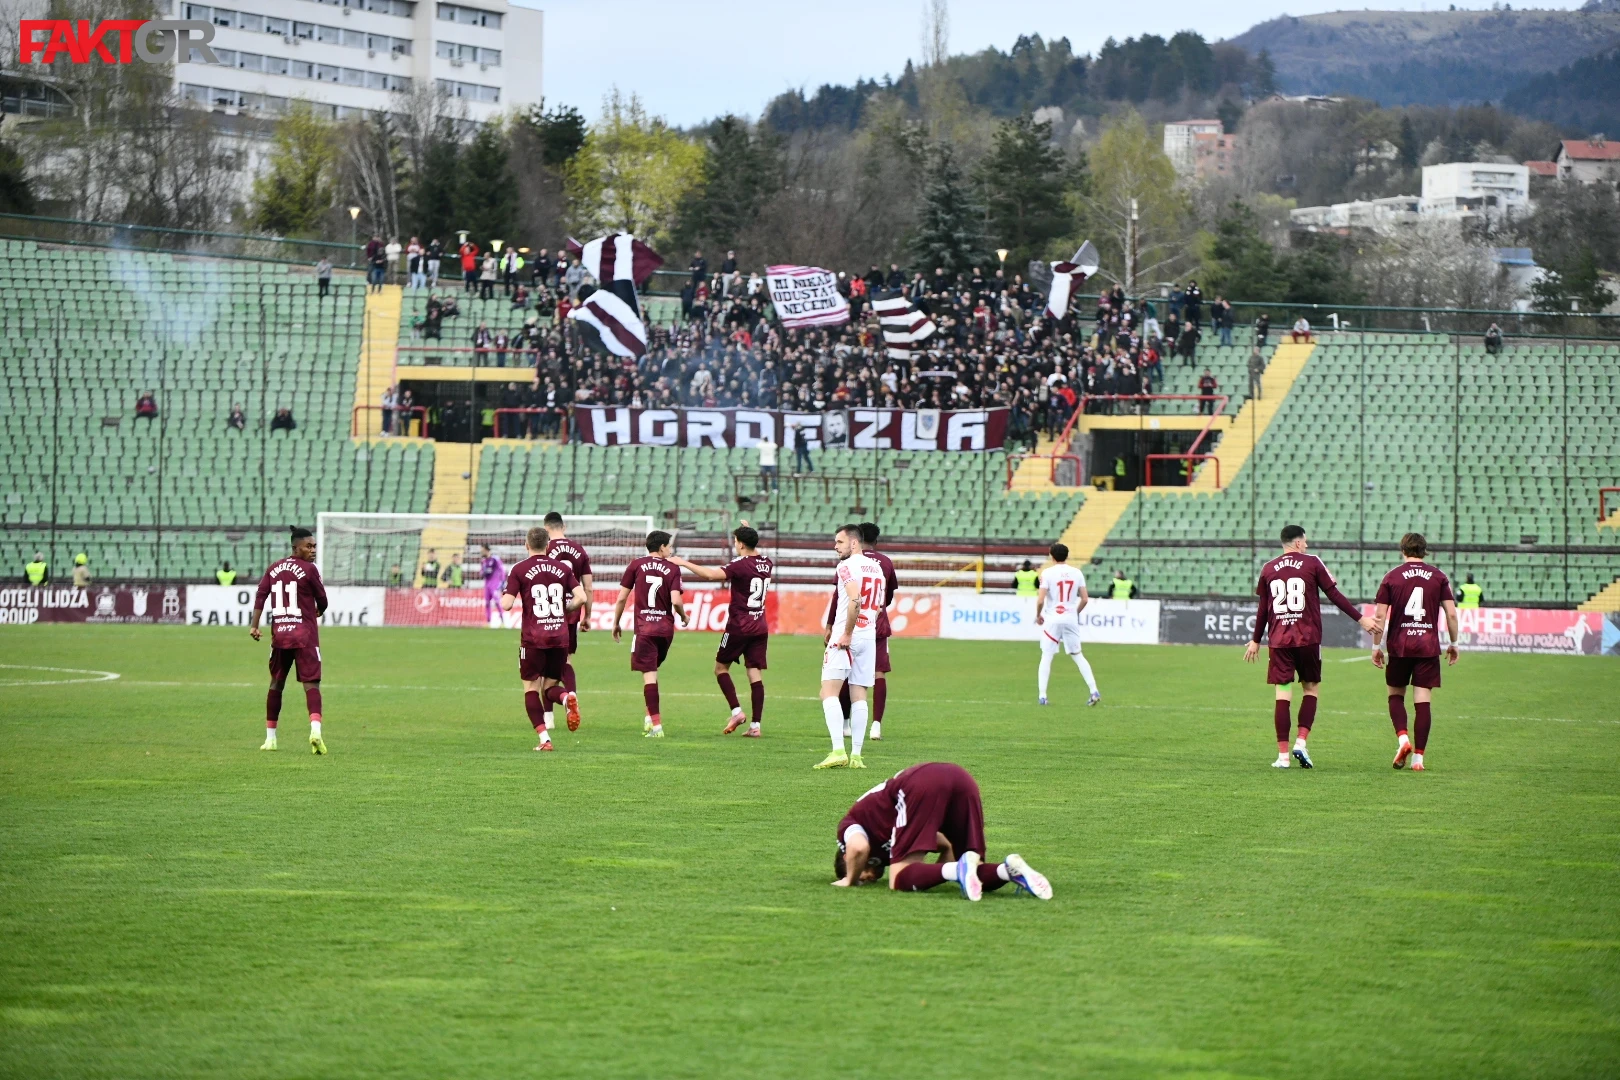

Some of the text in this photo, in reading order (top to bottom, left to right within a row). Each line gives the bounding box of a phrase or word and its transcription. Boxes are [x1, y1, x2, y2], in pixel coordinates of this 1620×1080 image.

[853, 411, 989, 450] ZLA
[1273, 558, 1304, 572] BRALIĆ
[42, 586, 89, 609] ILIDŽA
[271, 579, 302, 617] 11
[530, 582, 565, 618] 33
[645, 575, 663, 608] 7
[1056, 580, 1075, 603] 17
[1269, 577, 1306, 615] 28
[1403, 586, 1427, 622] 4
[952, 608, 1021, 625] PHILIPS
[1077, 612, 1125, 628] LIGHT
